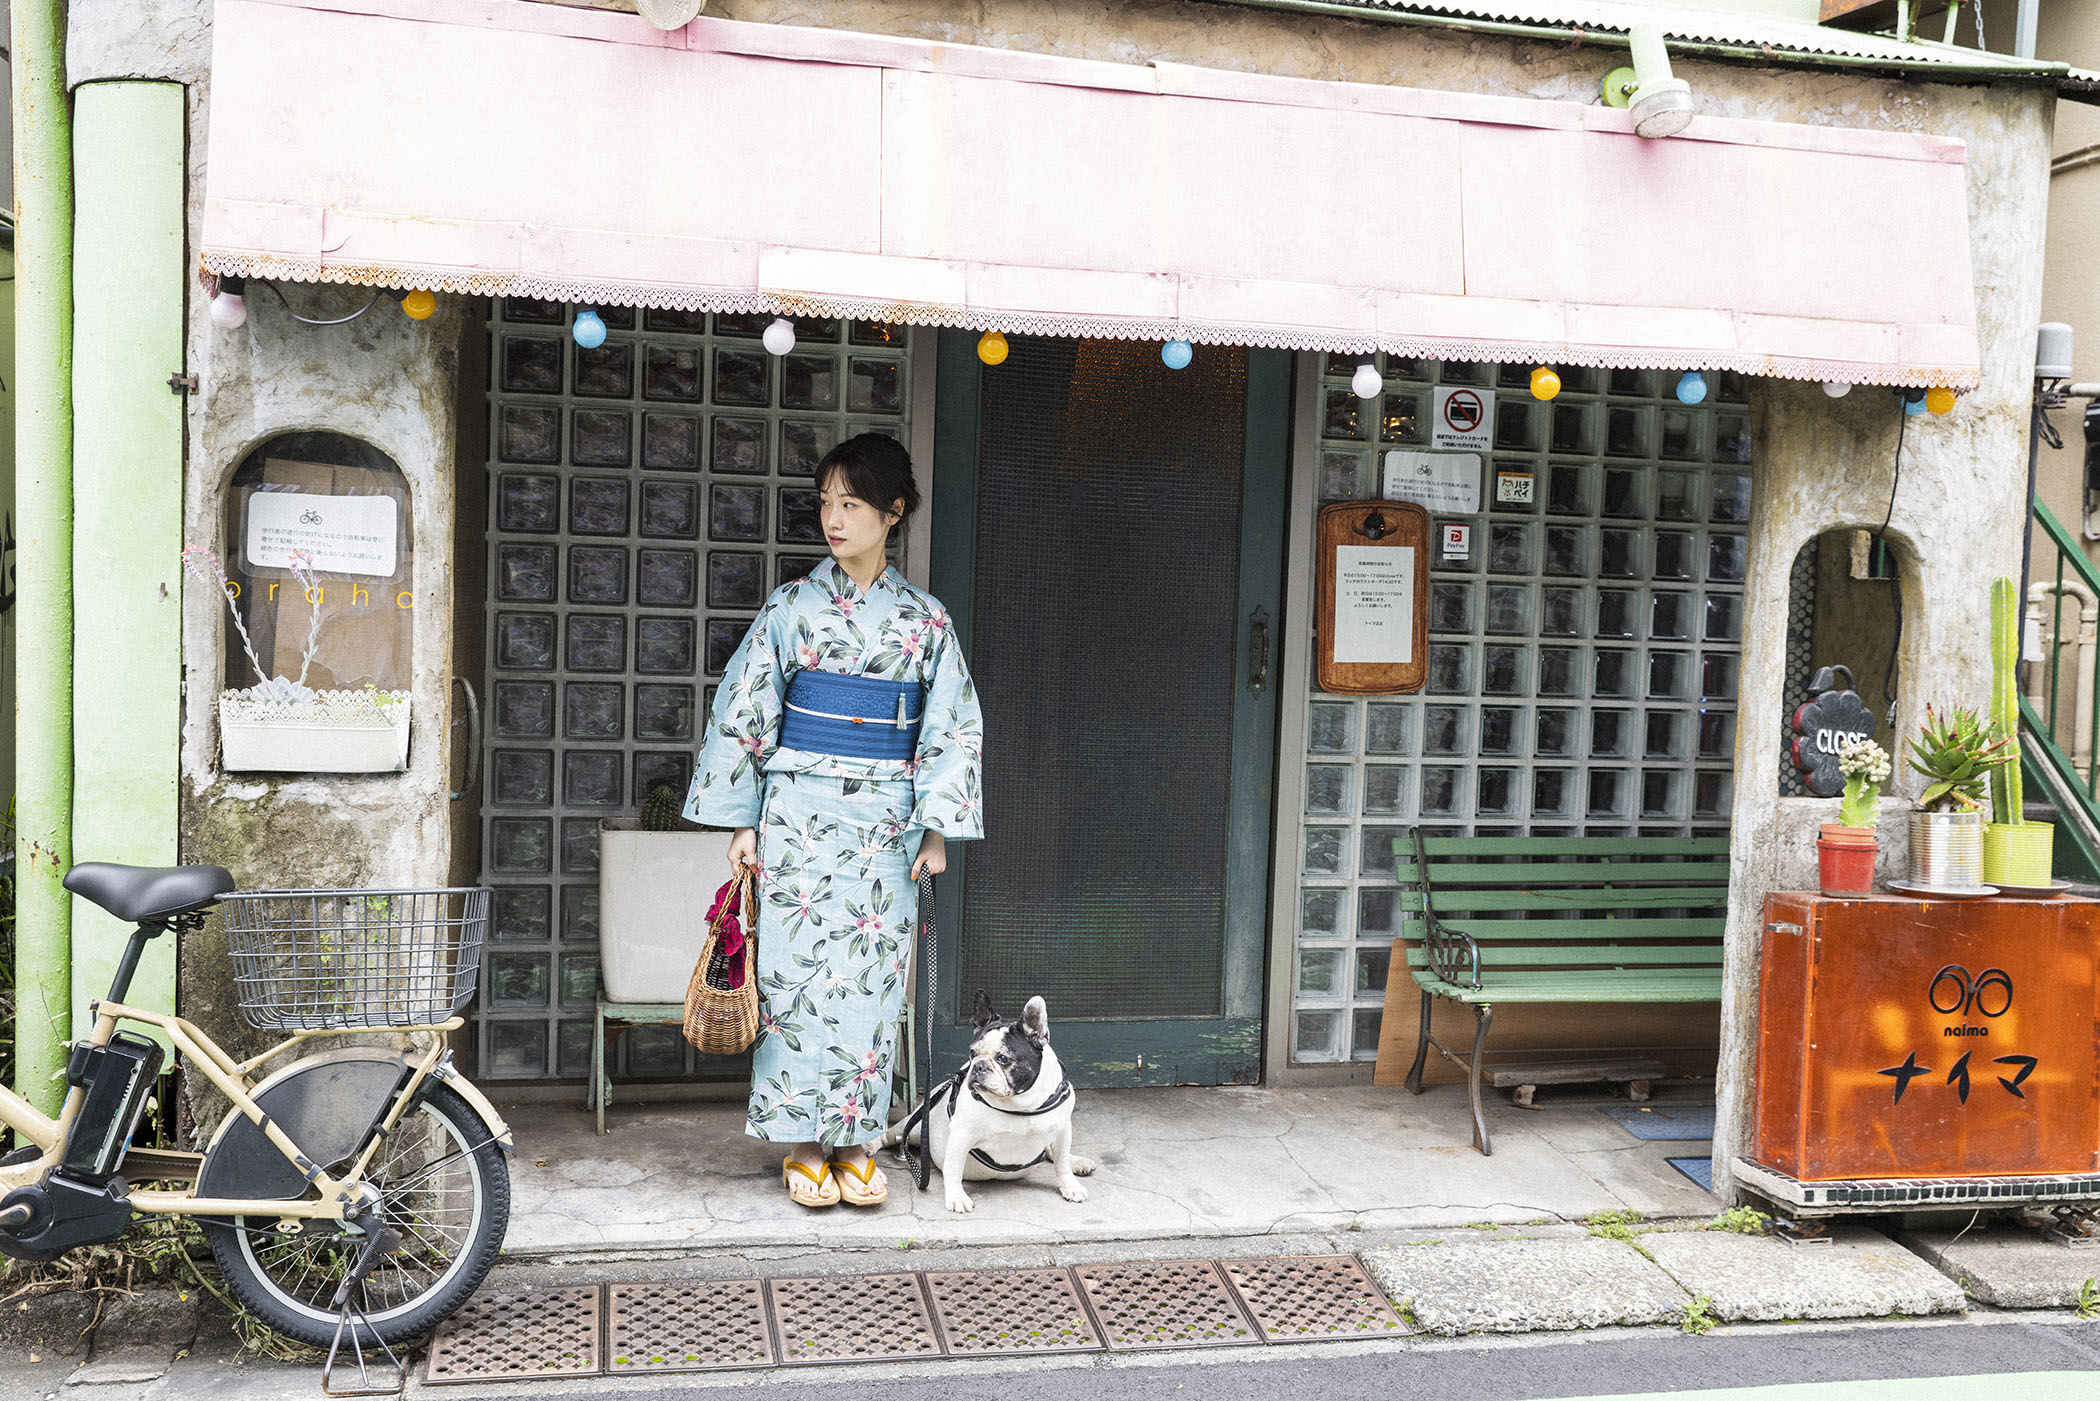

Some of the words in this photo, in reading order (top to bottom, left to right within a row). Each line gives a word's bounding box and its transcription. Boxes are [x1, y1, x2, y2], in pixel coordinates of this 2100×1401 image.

[1514, 480, 1530, 490] ハチ
[1513, 489, 1529, 498] ペイ
[1943, 1024, 1989, 1037] naima
[1876, 1050, 2039, 1107] ナイマ
